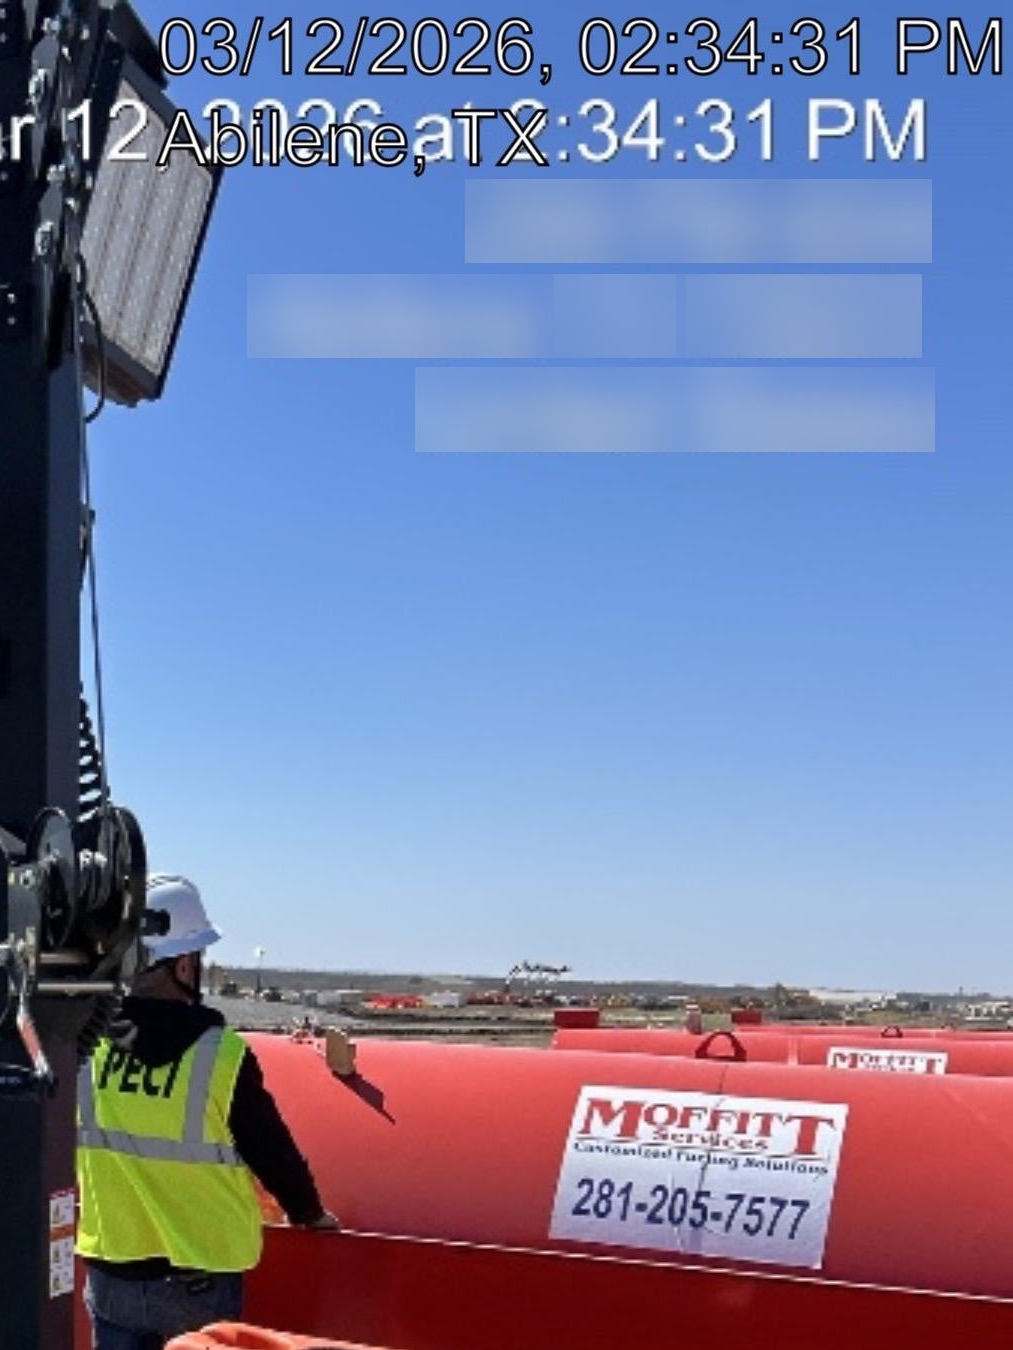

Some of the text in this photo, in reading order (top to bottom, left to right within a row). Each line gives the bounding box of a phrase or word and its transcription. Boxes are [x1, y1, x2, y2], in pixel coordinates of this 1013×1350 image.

[578, 1099, 837, 1157] MOFFITT
[652, 1127, 770, 1151] Services
[574, 1141, 674, 1161] Customized
[570, 1177, 811, 1240] 281-205-7577
